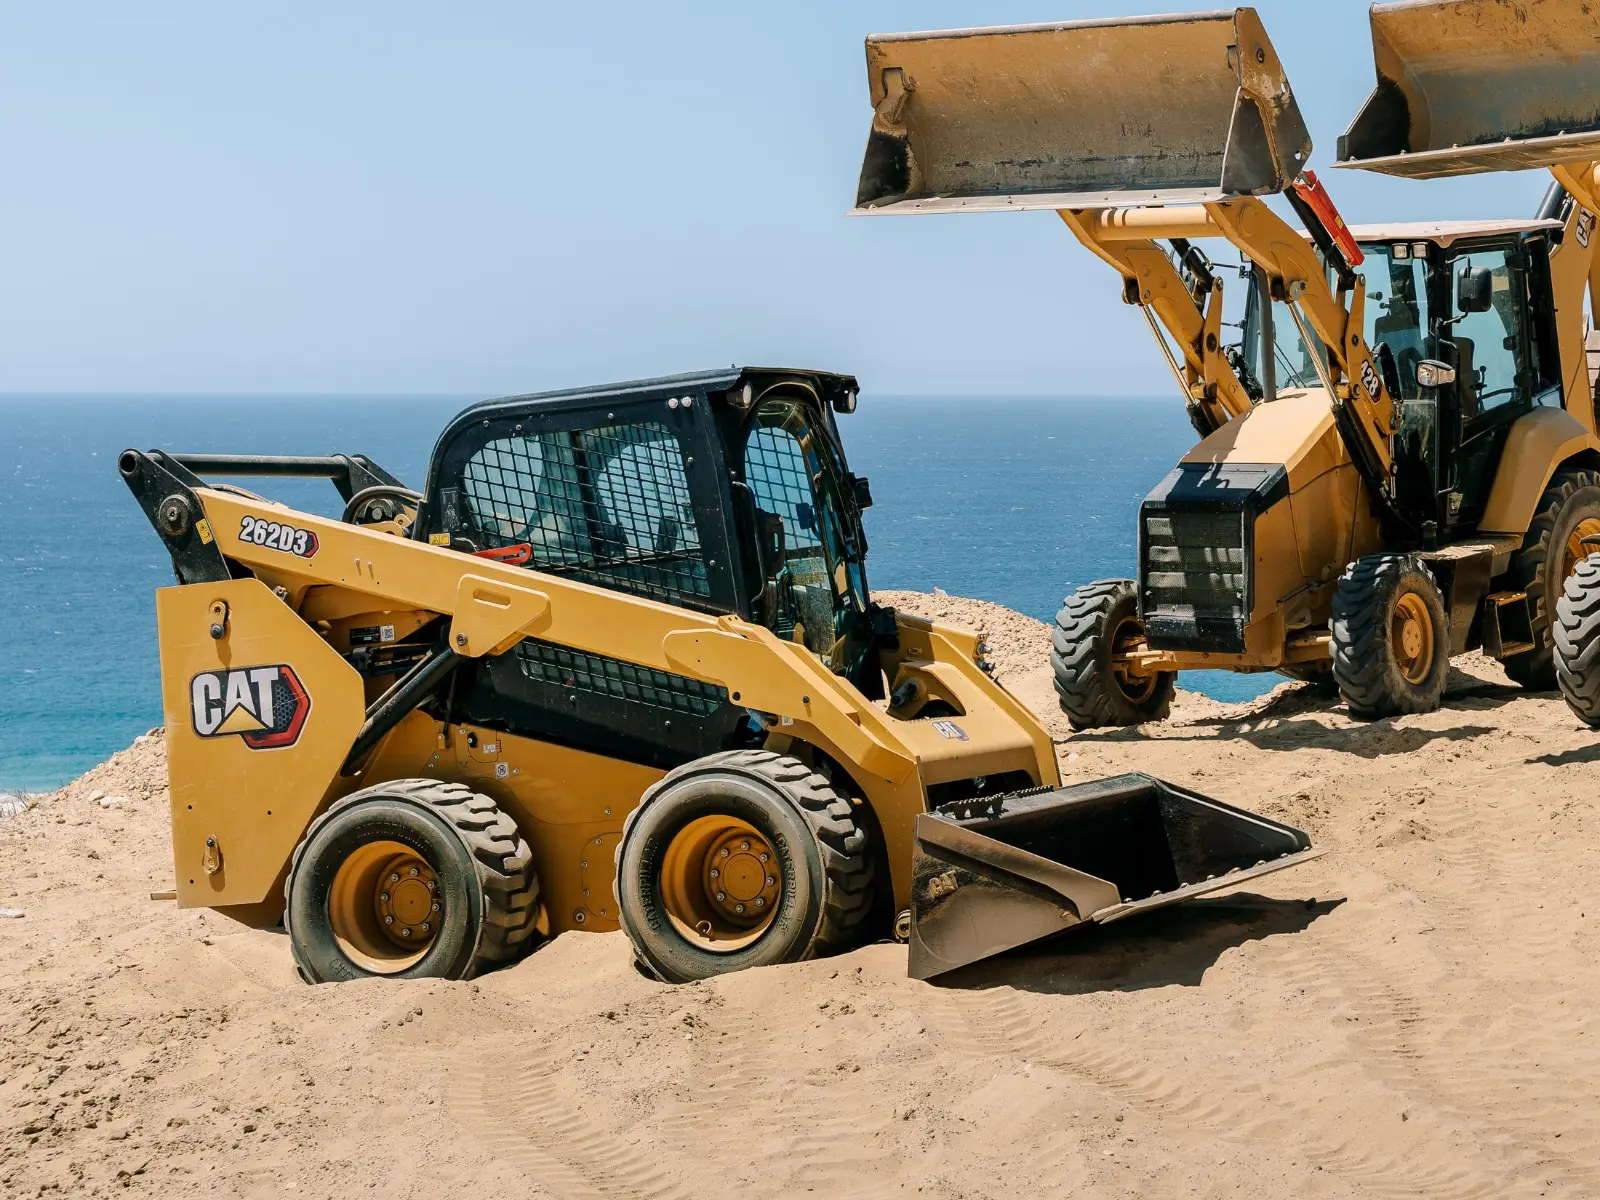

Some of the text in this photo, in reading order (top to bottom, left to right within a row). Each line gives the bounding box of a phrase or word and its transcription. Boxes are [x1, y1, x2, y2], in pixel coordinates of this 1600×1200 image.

[240, 516, 307, 554] 262D3
[192, 667, 279, 735] CAT
[931, 721, 962, 738] CAT
[776, 836, 796, 936] CATERPILLAR
